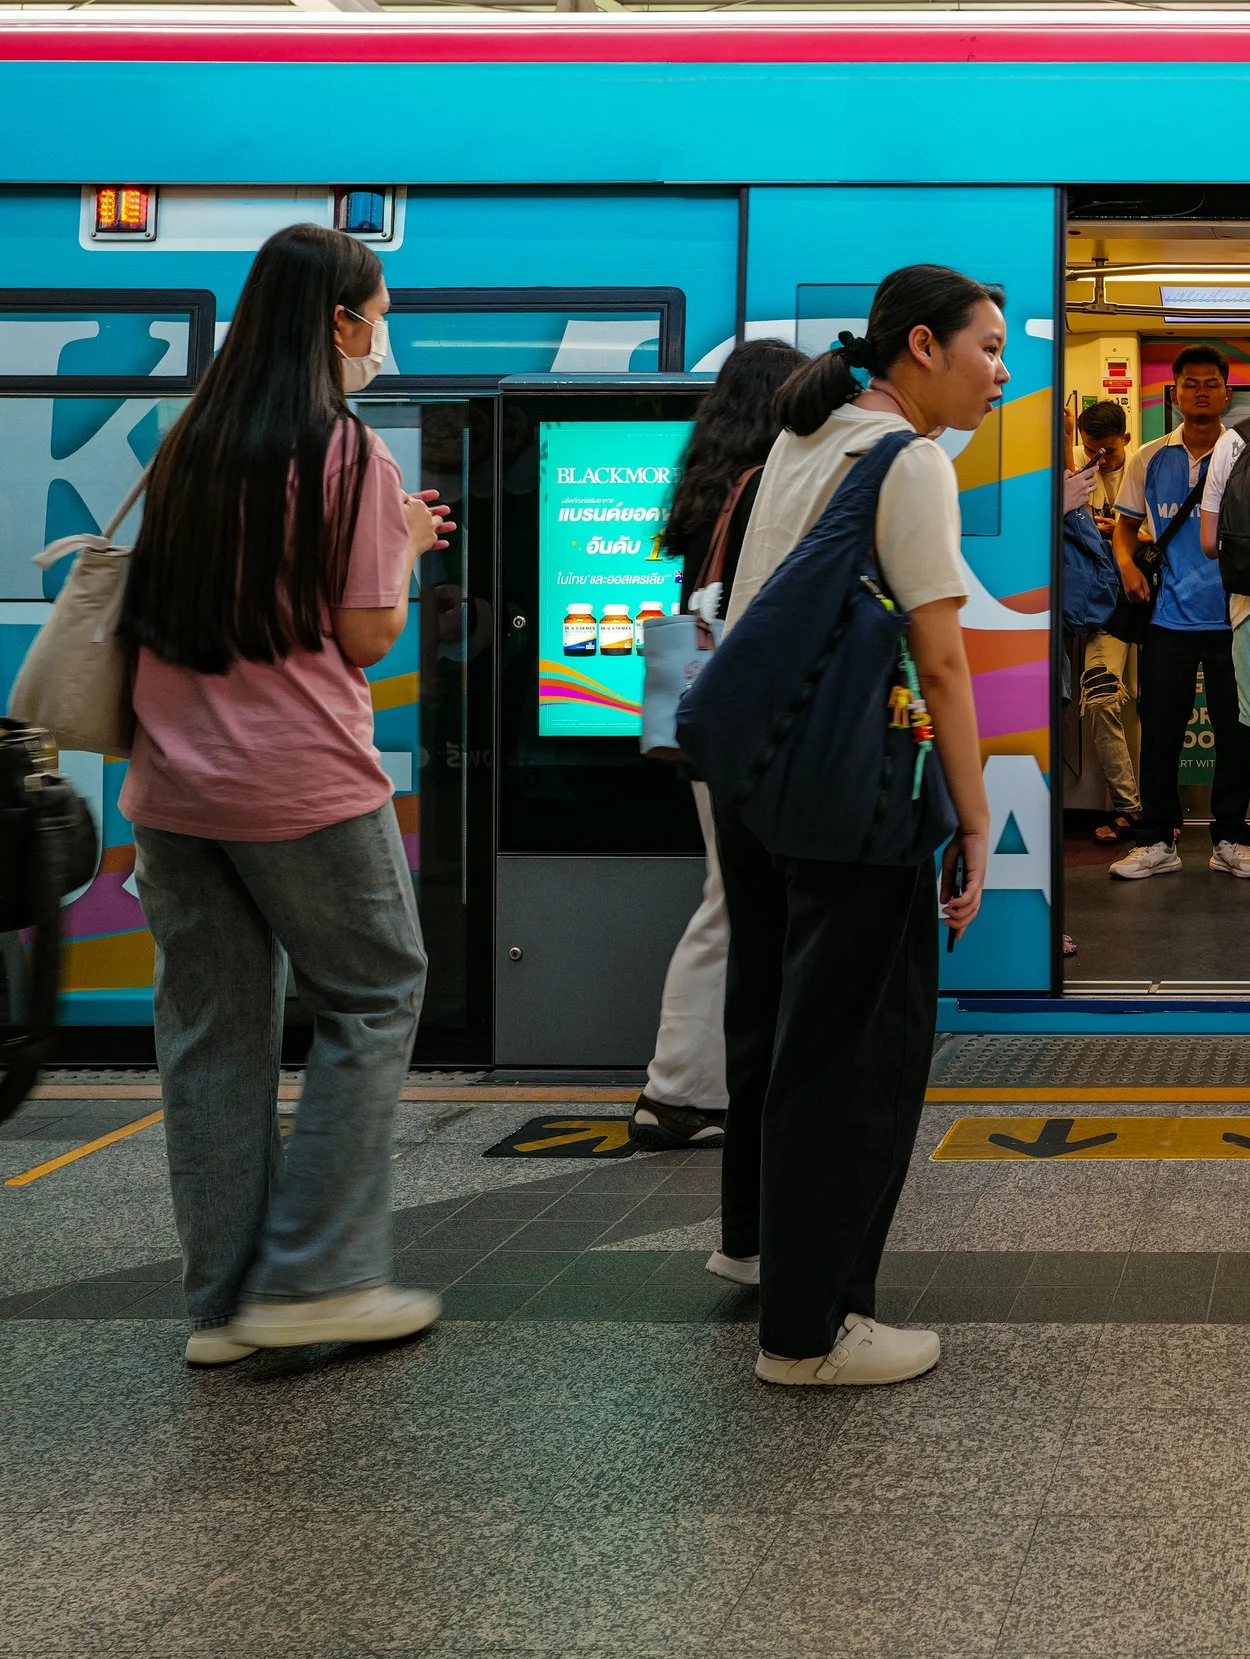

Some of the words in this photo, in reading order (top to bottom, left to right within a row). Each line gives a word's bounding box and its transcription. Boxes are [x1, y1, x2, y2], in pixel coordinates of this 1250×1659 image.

[586, 535, 641, 554] อันดับ
[644, 528, 667, 561] 1
